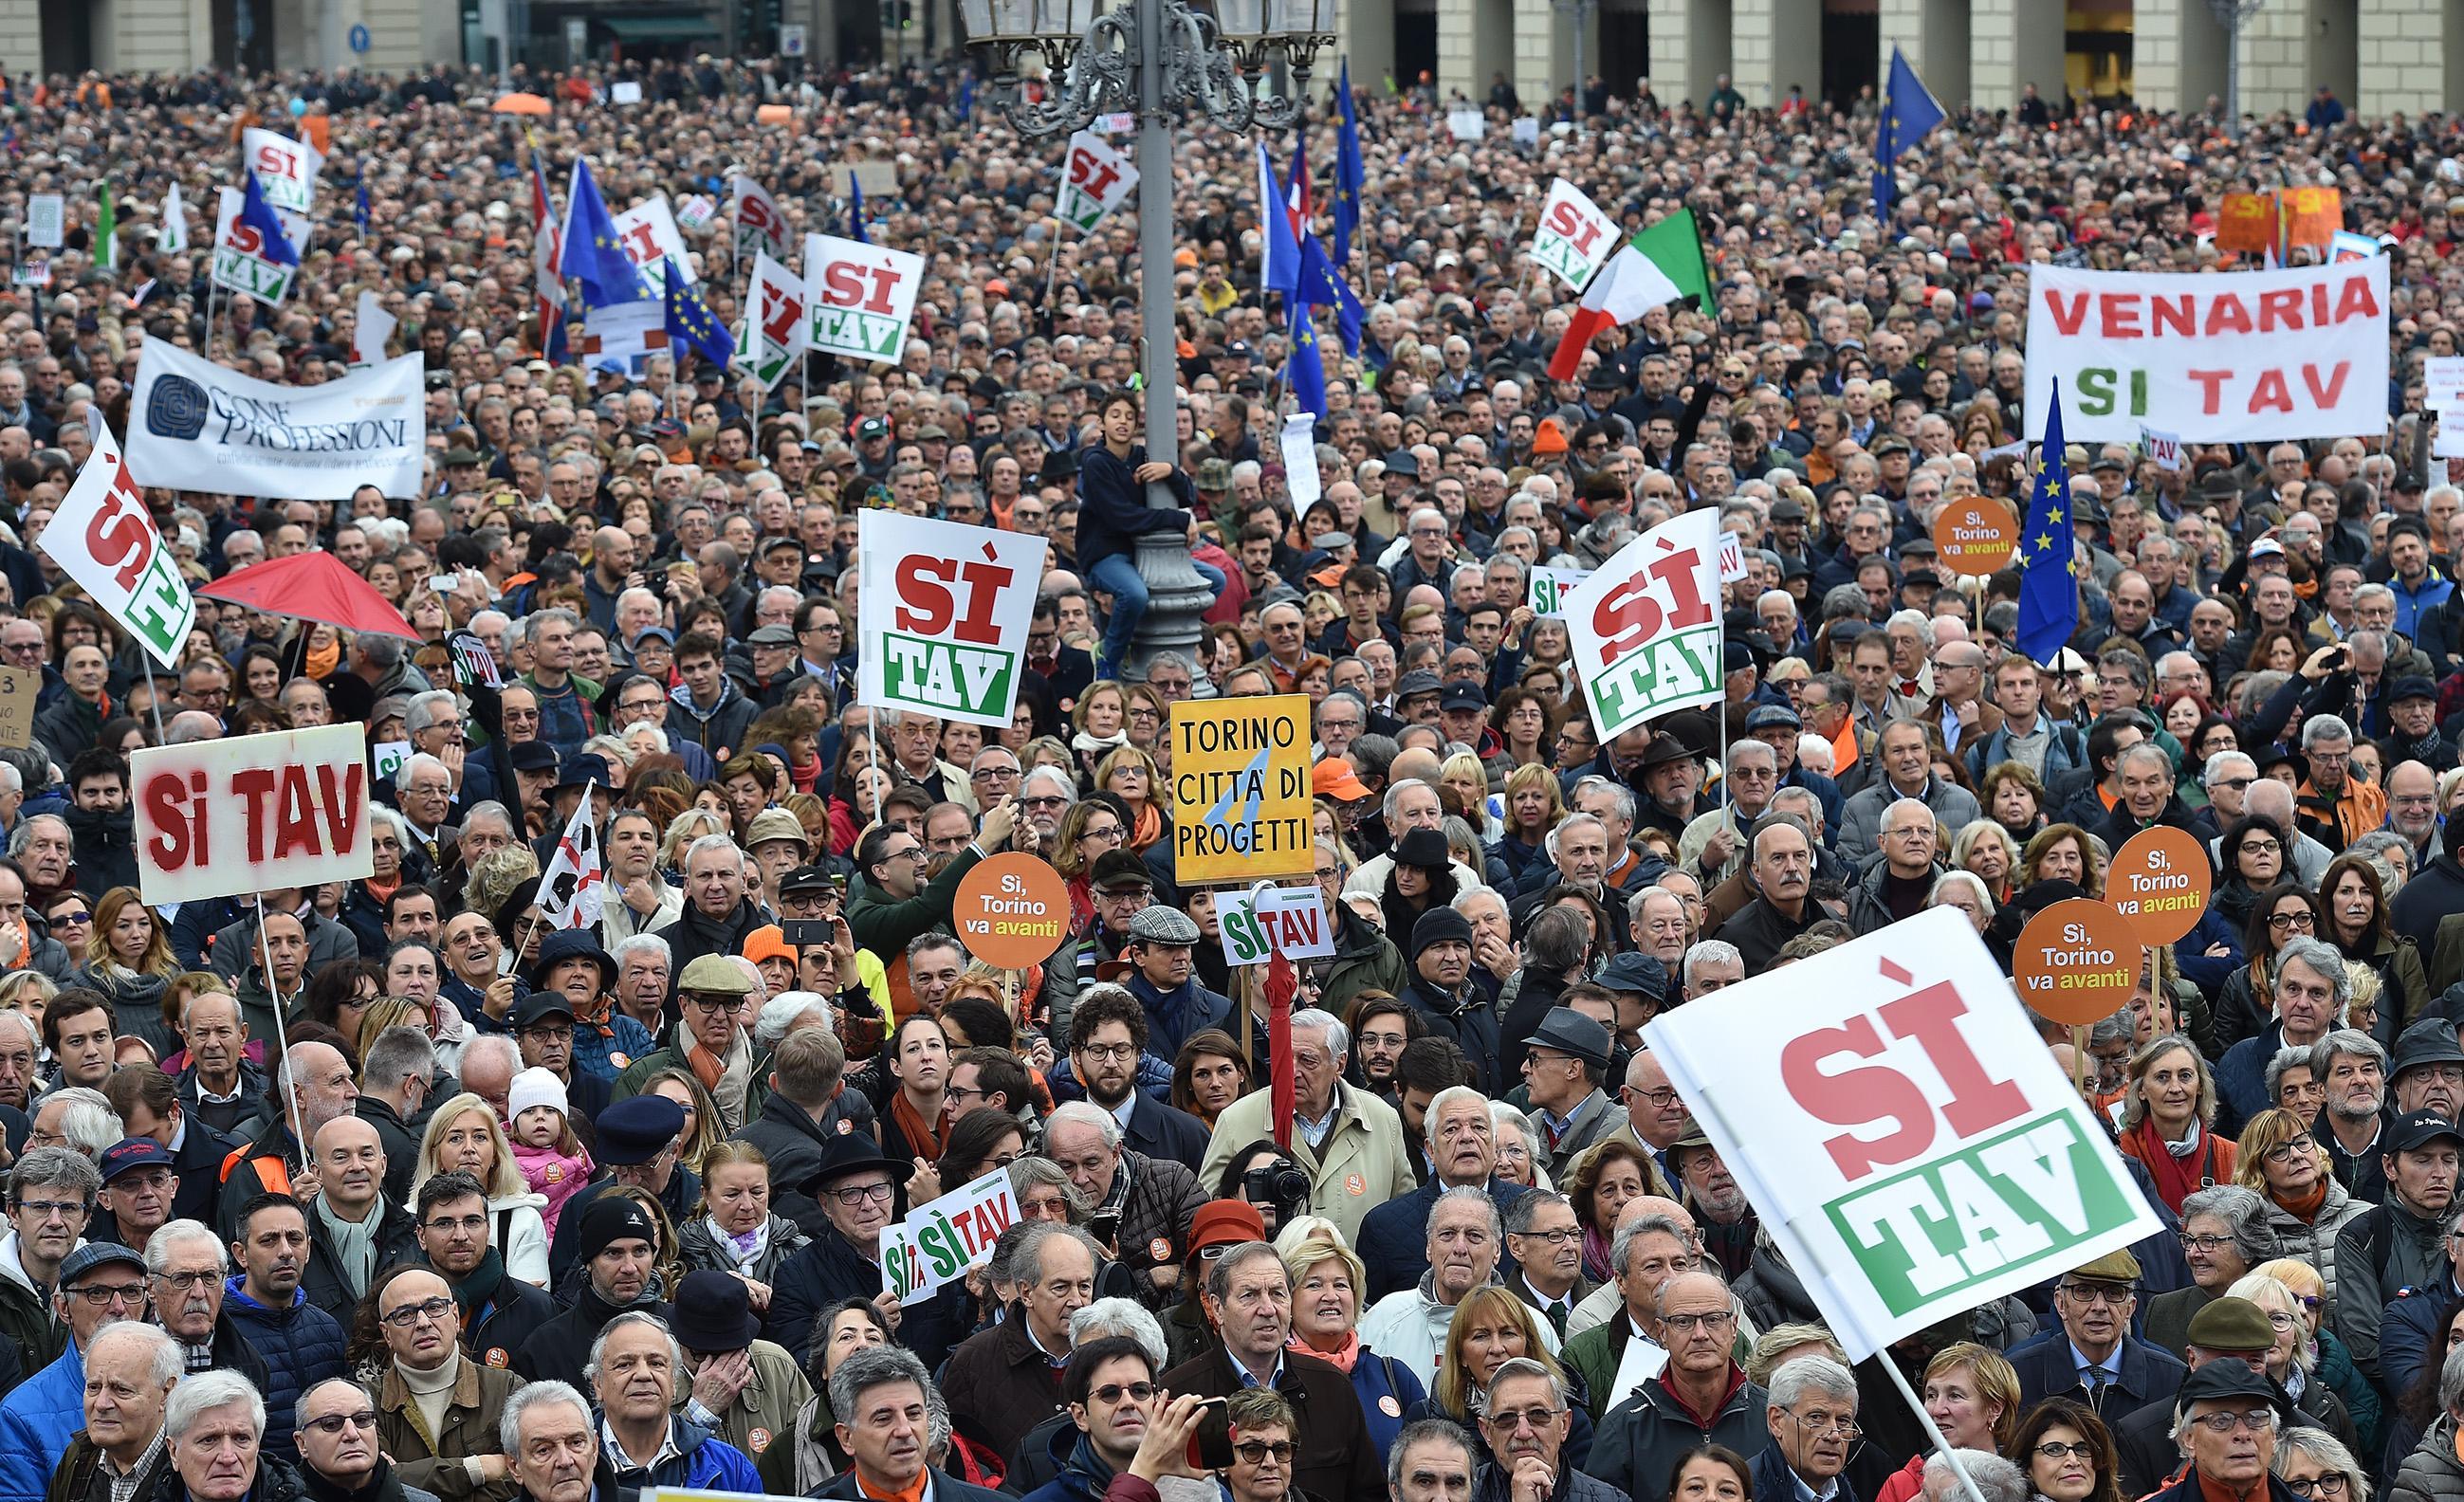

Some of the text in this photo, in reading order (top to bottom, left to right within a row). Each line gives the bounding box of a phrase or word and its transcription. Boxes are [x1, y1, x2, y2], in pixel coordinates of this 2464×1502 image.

[1545, 201, 1603, 257] SÌ
[822, 257, 901, 315] SÌ
[2044, 275, 2380, 339] VENARIA
[815, 306, 899, 352] TAV
[2076, 360, 2351, 416] SI TAV
[1943, 540, 2010, 555] va avanti
[1952, 526, 2000, 540] Torino
[1720, 545, 1738, 575] AV
[128, 544, 190, 640] TA
[895, 540, 1014, 646] SÌ
[1535, 573, 1556, 615] SÌ
[1592, 537, 1713, 667] SÌ
[888, 635, 1008, 710] TAV
[1596, 630, 1720, 719] TAV
[1180, 716, 1295, 753] TORINO
[1280, 766, 1304, 800] DI
[232, 762, 363, 863] TAV
[1179, 817, 1308, 857] PROGETTI
[2147, 850, 2171, 870] Sì,
[1001, 873, 1027, 896] Sì,
[2129, 871, 2189, 892] Torino
[980, 894, 1047, 916] Torino
[2117, 890, 2200, 916] va avanti
[965, 919, 1058, 937] va avanti
[2063, 923, 2092, 945] Sì,
[2041, 947, 2115, 967] Torino
[2026, 968, 2129, 990] va avanti
[1780, 955, 2032, 1182] SÌ
[1837, 1117, 2080, 1297] TAV
